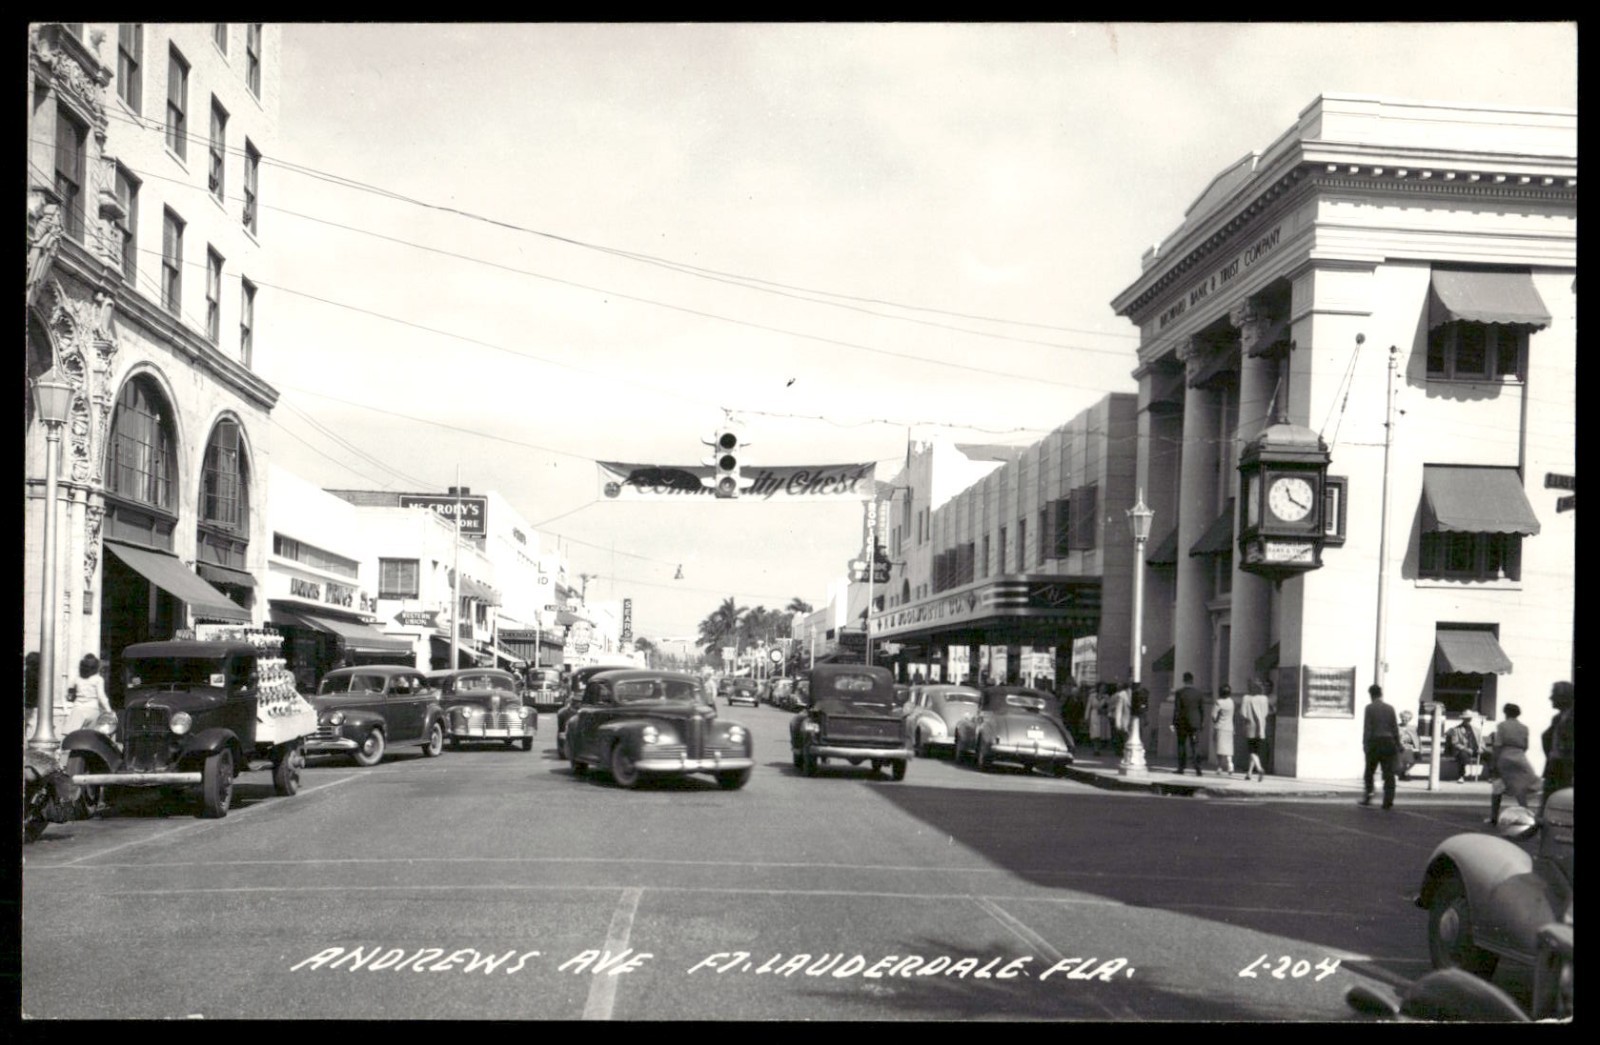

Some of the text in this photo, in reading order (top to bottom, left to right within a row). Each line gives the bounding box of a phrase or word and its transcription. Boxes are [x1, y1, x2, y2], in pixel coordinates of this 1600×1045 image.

[1190, 281, 1208, 306] BANK
[1219, 259, 1239, 284] TRUST
[1244, 226, 1281, 267] COMPANY
[786, 468, 866, 495] Chest
[402, 611, 431, 620] WESTERN
